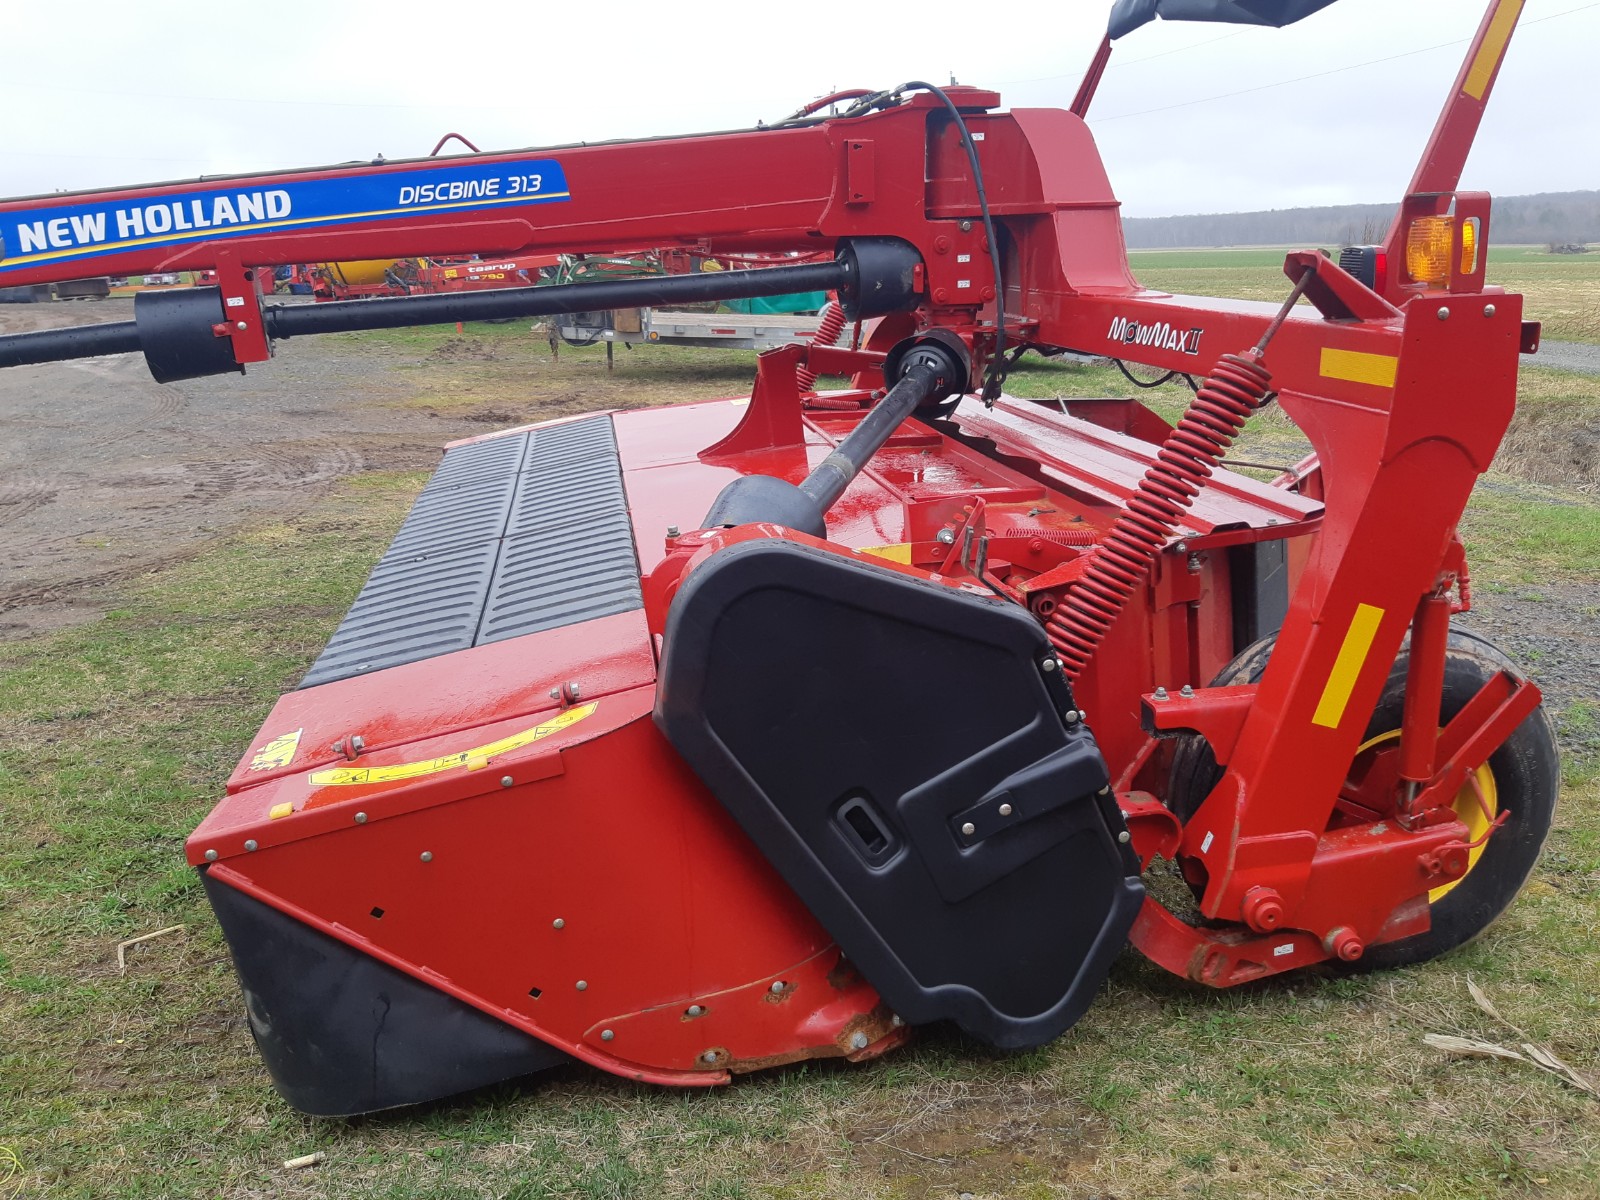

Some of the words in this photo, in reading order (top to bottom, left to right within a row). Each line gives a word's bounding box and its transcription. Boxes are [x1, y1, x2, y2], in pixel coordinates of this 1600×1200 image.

[399, 178, 501, 205] DISCBINE
[506, 174, 542, 195] 313
[17, 212, 106, 253] NEW
[115, 189, 292, 239] HOLLAND
[467, 263, 516, 273] taarup
